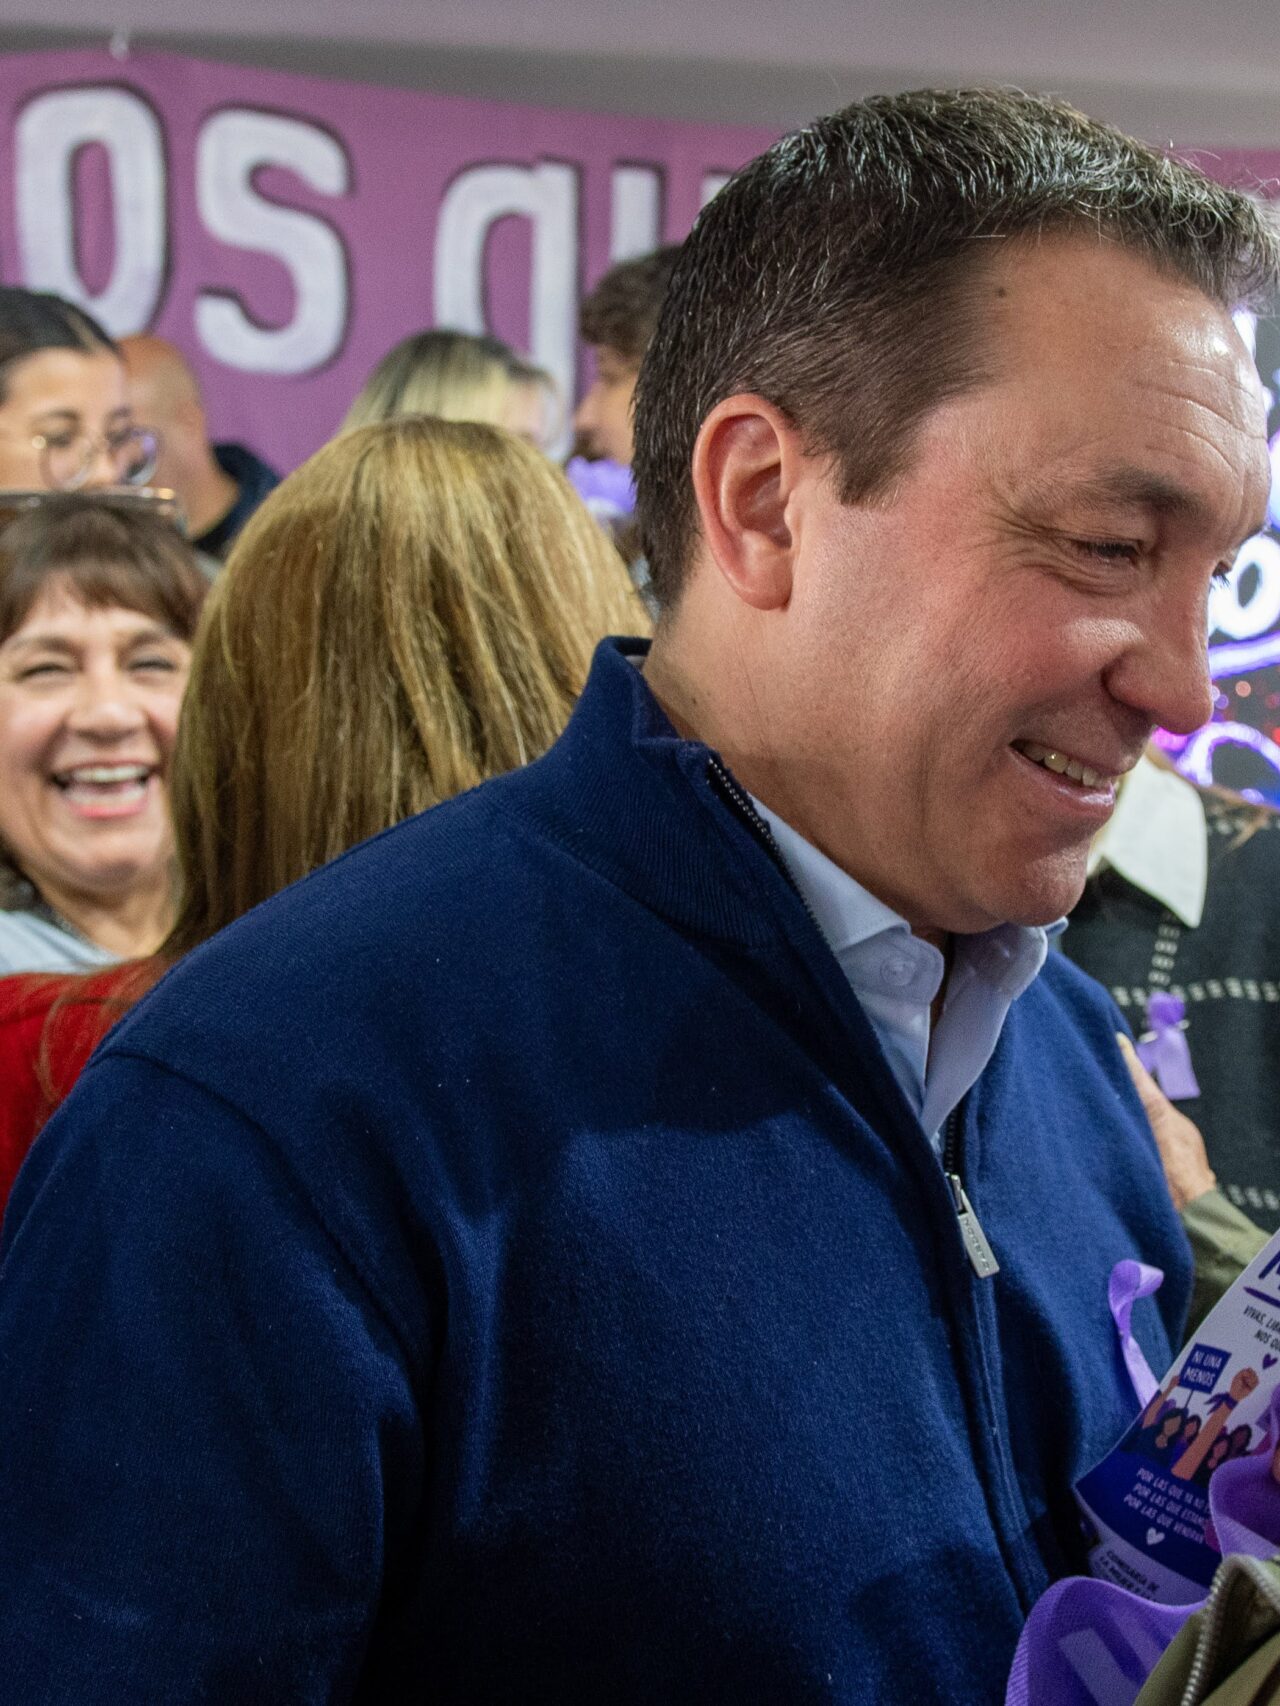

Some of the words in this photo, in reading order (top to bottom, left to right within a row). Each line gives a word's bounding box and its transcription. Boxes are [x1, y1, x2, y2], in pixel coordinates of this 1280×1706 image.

[1254, 1329, 1272, 1344] NOS
[1191, 1350, 1206, 1364] NI
[1202, 1353, 1223, 1370] UNA
[1183, 1366, 1216, 1388] MENOS
[1136, 1467, 1154, 1483] POR
[1153, 1477, 1170, 1492] LAS
[1167, 1484, 1184, 1500] QUE
[1123, 1493, 1142, 1510] POR
[1140, 1504, 1158, 1520] LAS
[1156, 1513, 1174, 1529] QUE
[1132, 1482, 1152, 1499] POR
[1150, 1492, 1167, 1508] LAS
[1165, 1500, 1182, 1516] QUE
